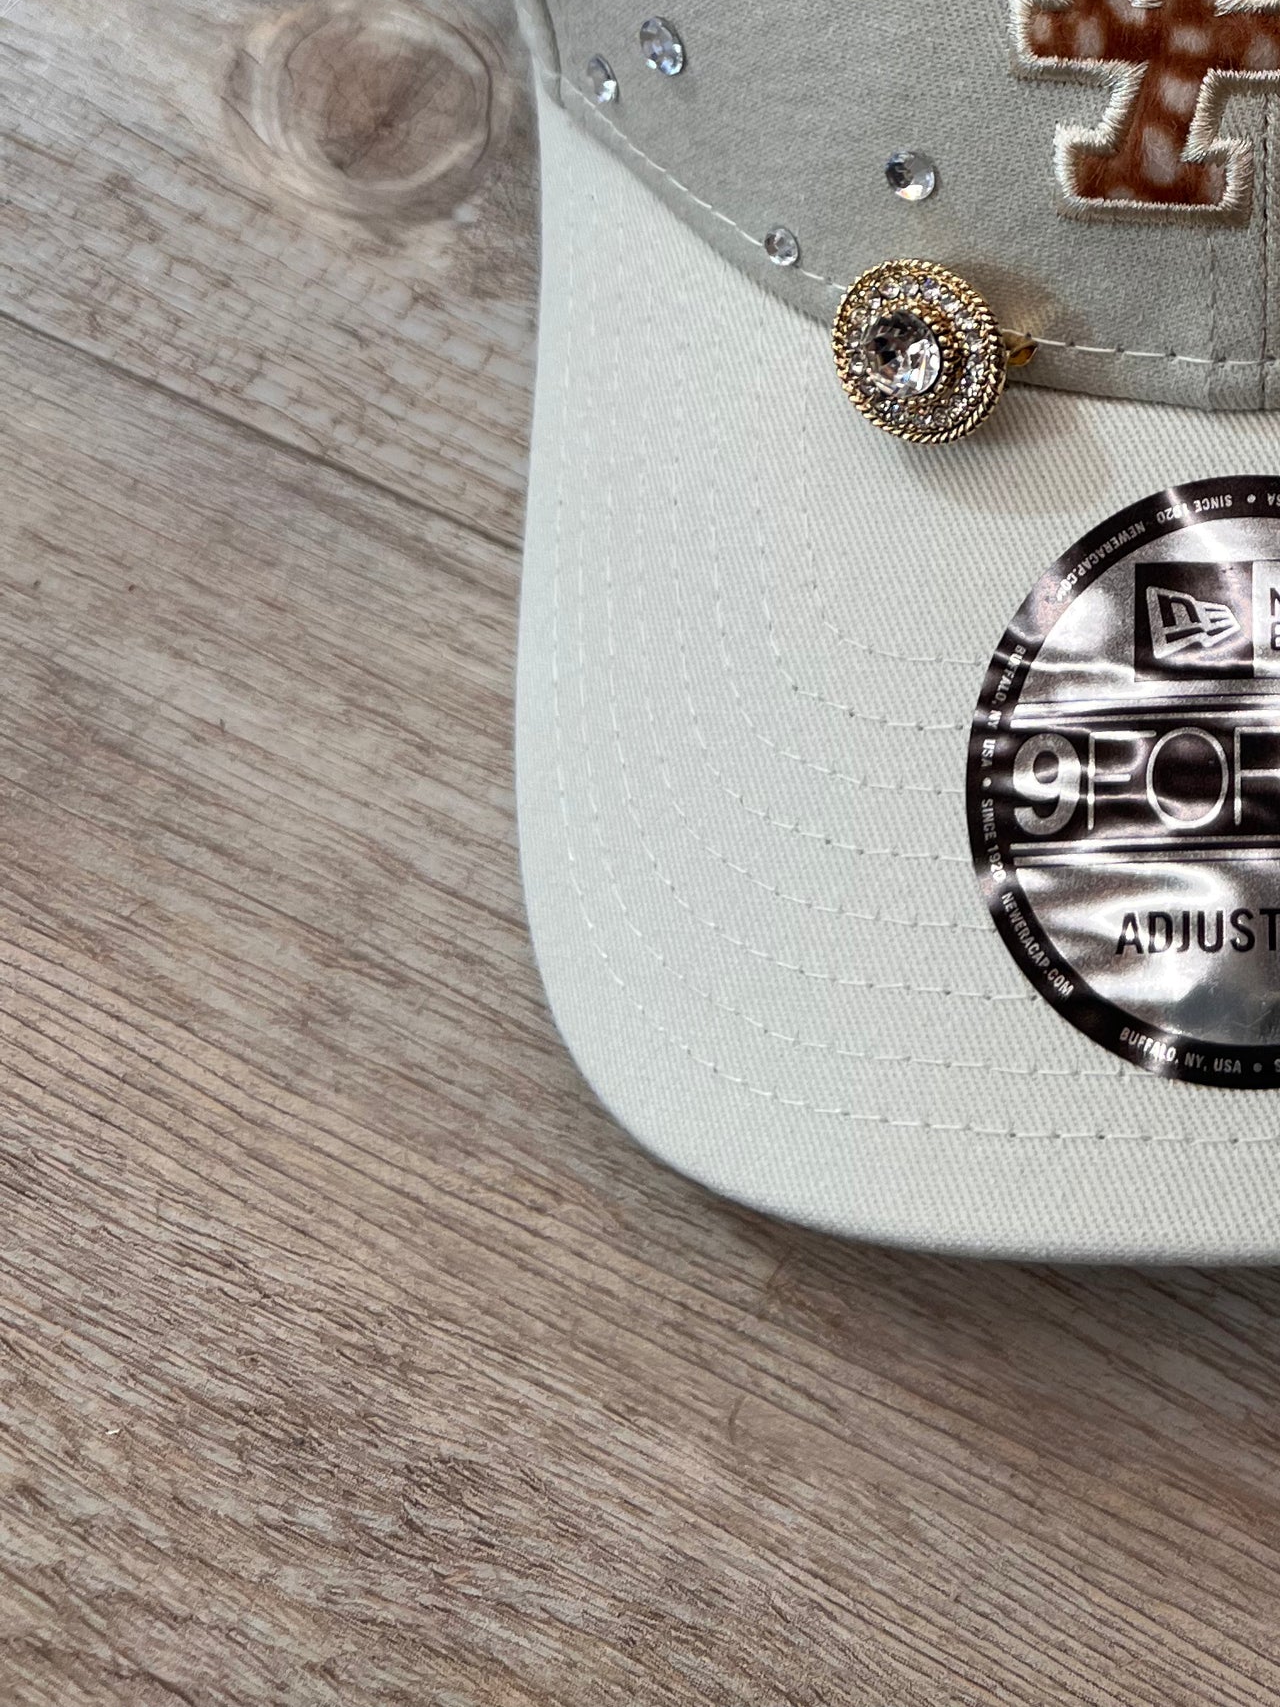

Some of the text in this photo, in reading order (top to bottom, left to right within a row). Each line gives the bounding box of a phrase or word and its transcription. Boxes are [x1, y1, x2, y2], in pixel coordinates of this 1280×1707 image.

[1156, 502, 1190, 523] 1920
[1192, 493, 1232, 513] SINCE
[981, 737, 997, 767] USA
[981, 798, 997, 841] SINCE
[986, 845, 1007, 883] 1920
[1001, 892, 1074, 998] NEWERACAP.COM
[1213, 1057, 1242, 1073] USA
